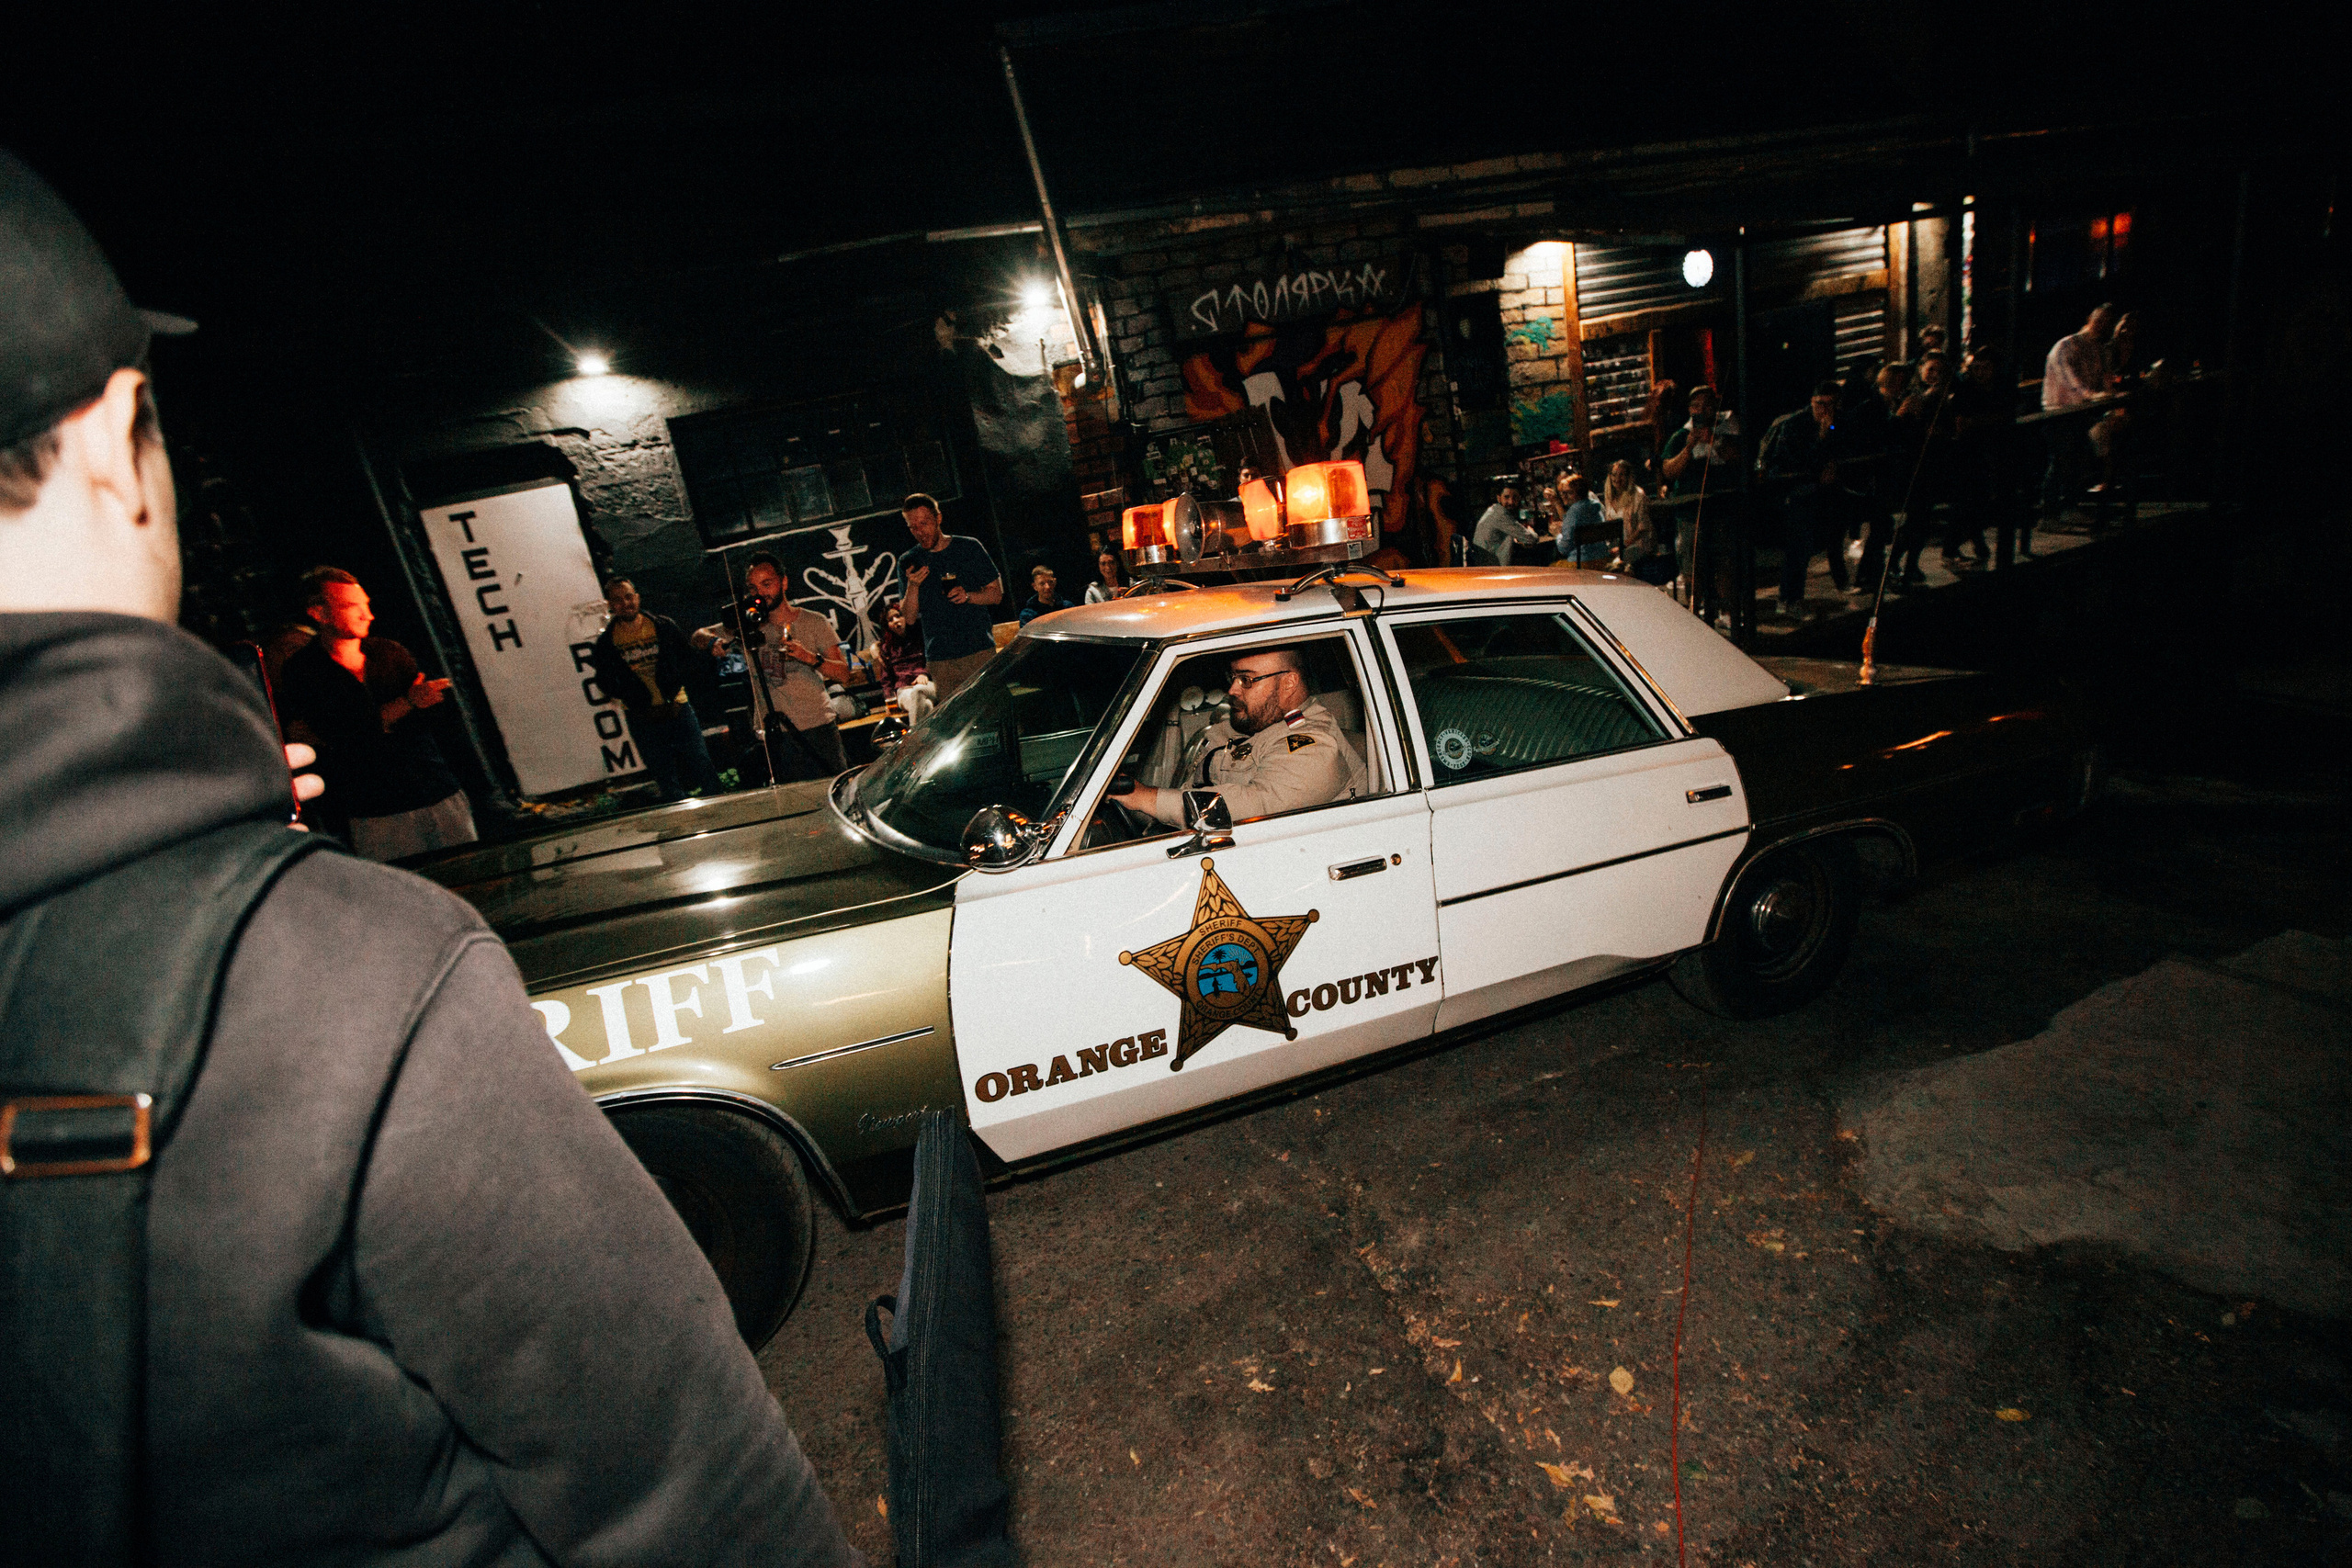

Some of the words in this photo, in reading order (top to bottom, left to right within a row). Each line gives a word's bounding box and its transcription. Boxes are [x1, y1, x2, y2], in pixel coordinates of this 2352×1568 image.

[449, 511, 522, 651] TECH
[1199, 919, 1242, 936] SHERIFF
[1192, 933, 1236, 965] SHERIFF'S
[1195, 999, 1232, 1019] ORANGE
[1233, 986, 1264, 1016] COUNTY
[975, 1028, 1169, 1103] ORANGE
[1286, 955, 1440, 1018] COUNTY
